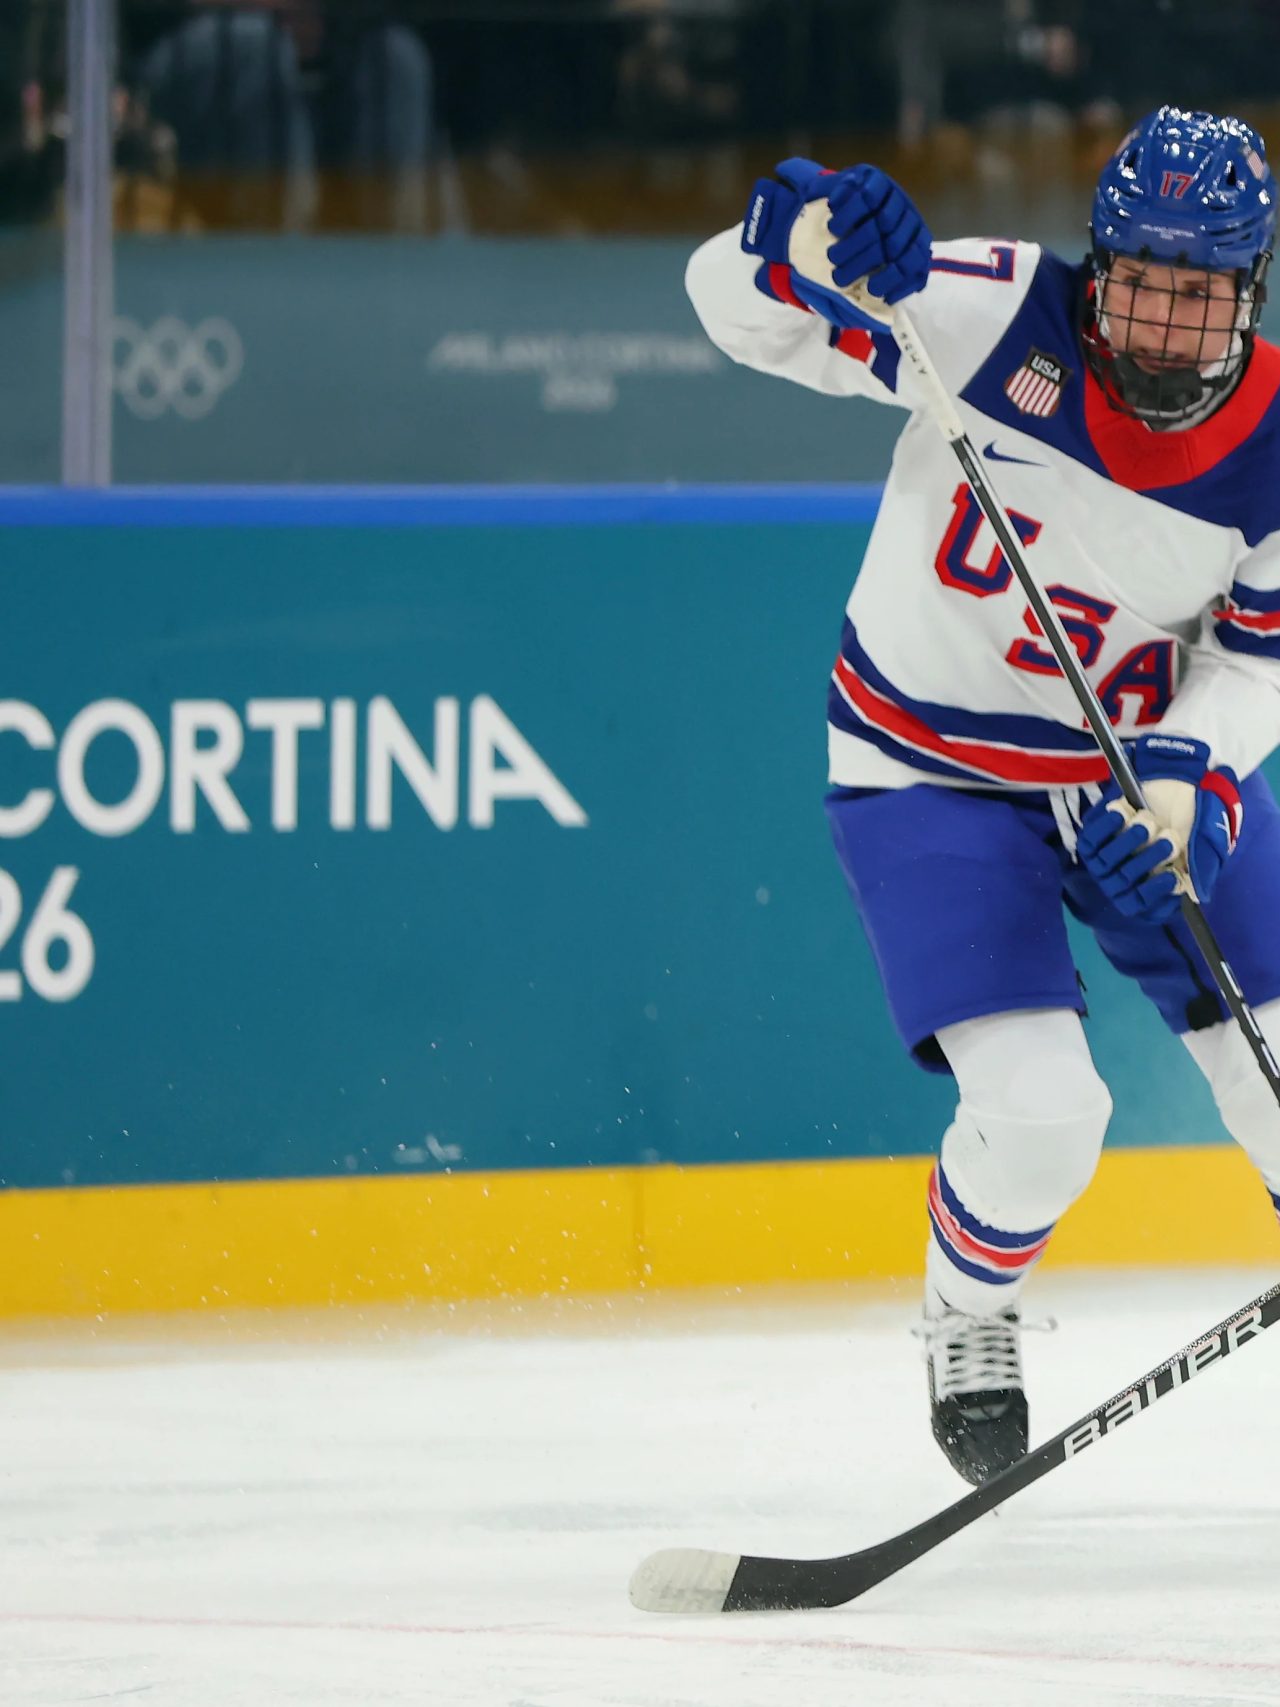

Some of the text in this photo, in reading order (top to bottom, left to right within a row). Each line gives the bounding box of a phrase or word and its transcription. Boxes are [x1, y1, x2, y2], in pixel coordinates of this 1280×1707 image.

[1159, 170, 1194, 200] 17
[1030, 354, 1062, 383] USA
[1063, 1306, 1266, 1461] BAUER
